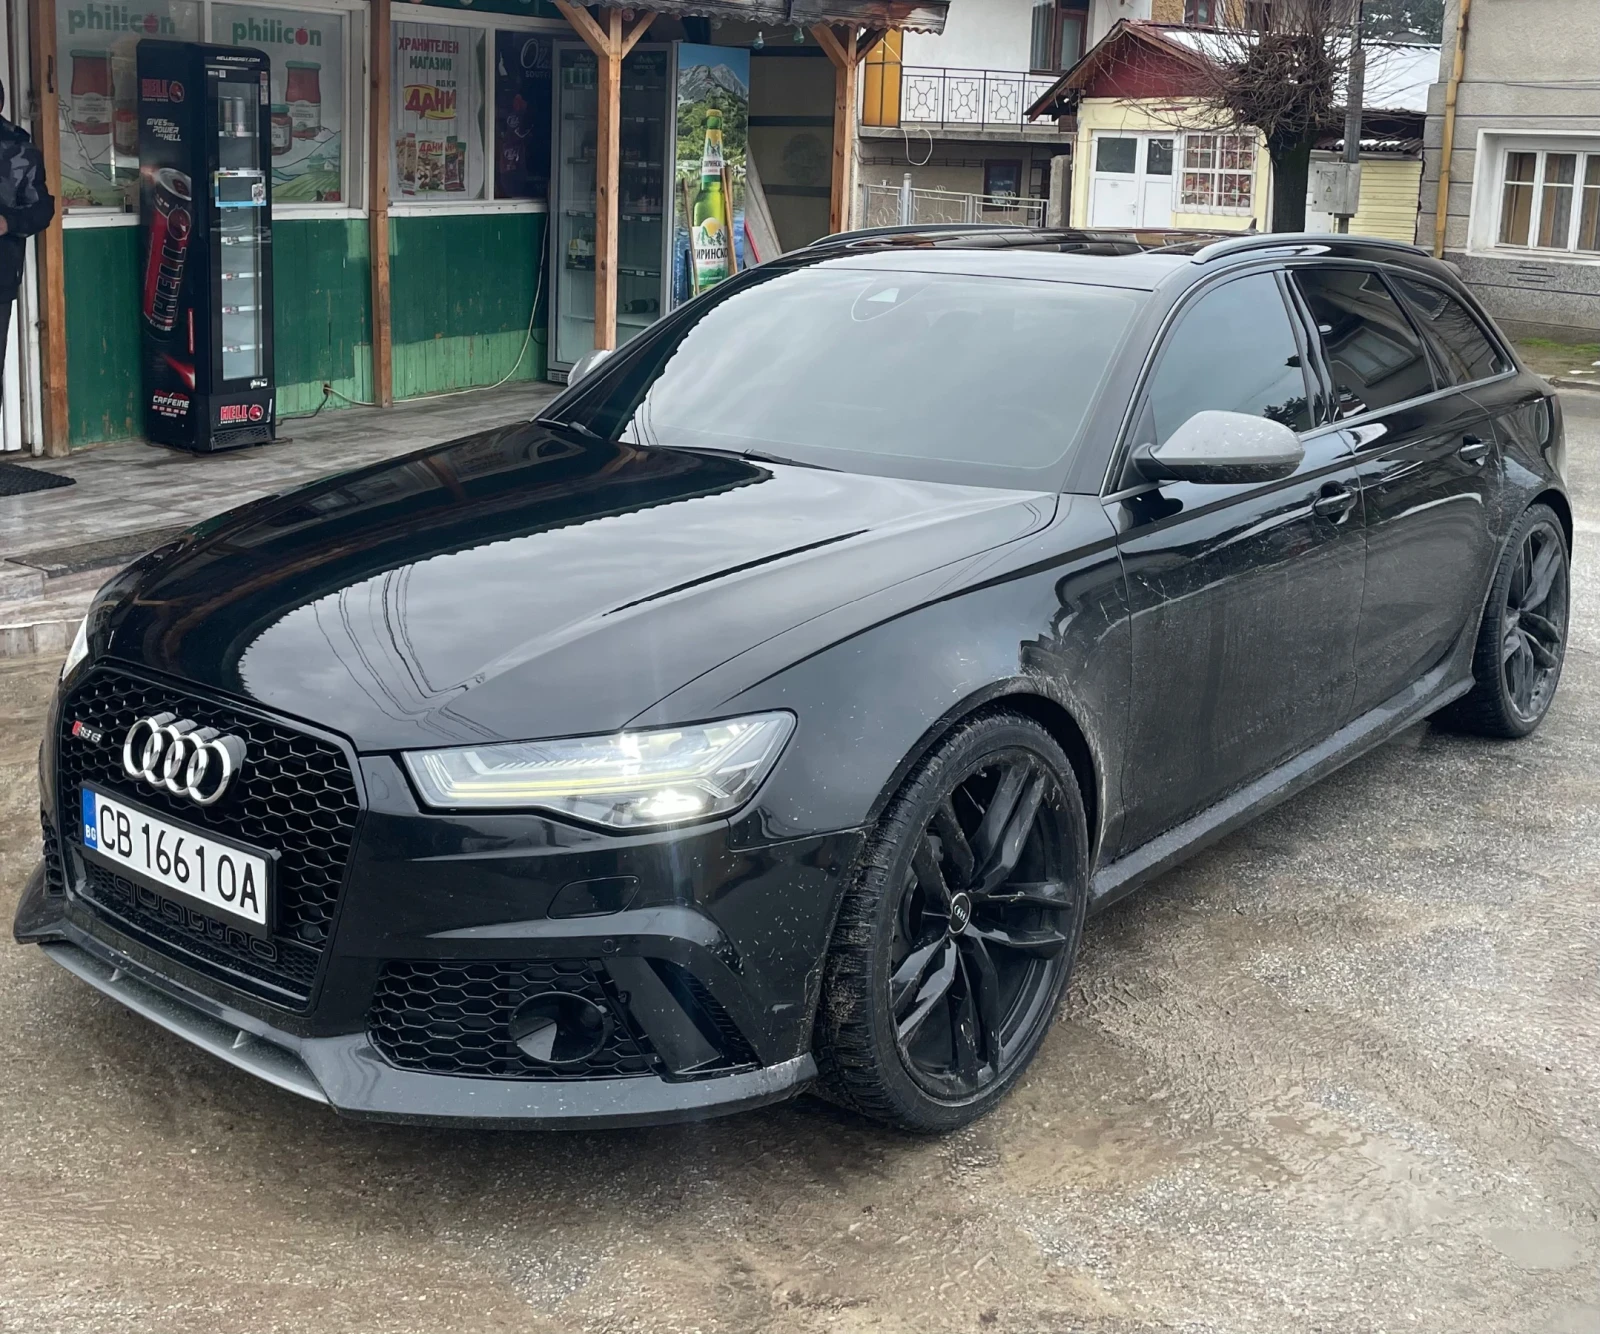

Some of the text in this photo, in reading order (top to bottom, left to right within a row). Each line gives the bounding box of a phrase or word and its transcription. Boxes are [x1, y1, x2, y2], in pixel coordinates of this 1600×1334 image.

[68, 3, 176, 34] philicon
[232, 18, 321, 46] philicon
[398, 37, 459, 54] ХРАНИТЕЛЕН
[410, 55, 452, 71] МАГАЗИН
[405, 88, 456, 119] ДАНИ
[147, 118, 168, 126] GIVES
[153, 126, 179, 134] POWER
[163, 133, 181, 141] HELL
[419, 142, 443, 155] ДАНИ
[695, 248, 729, 260] ИРИНСКО
[153, 245, 187, 319] HELL
[153, 393, 189, 409] CAFFEINE
[220, 405, 248, 420] HELL
[85, 824, 97, 841] BG
